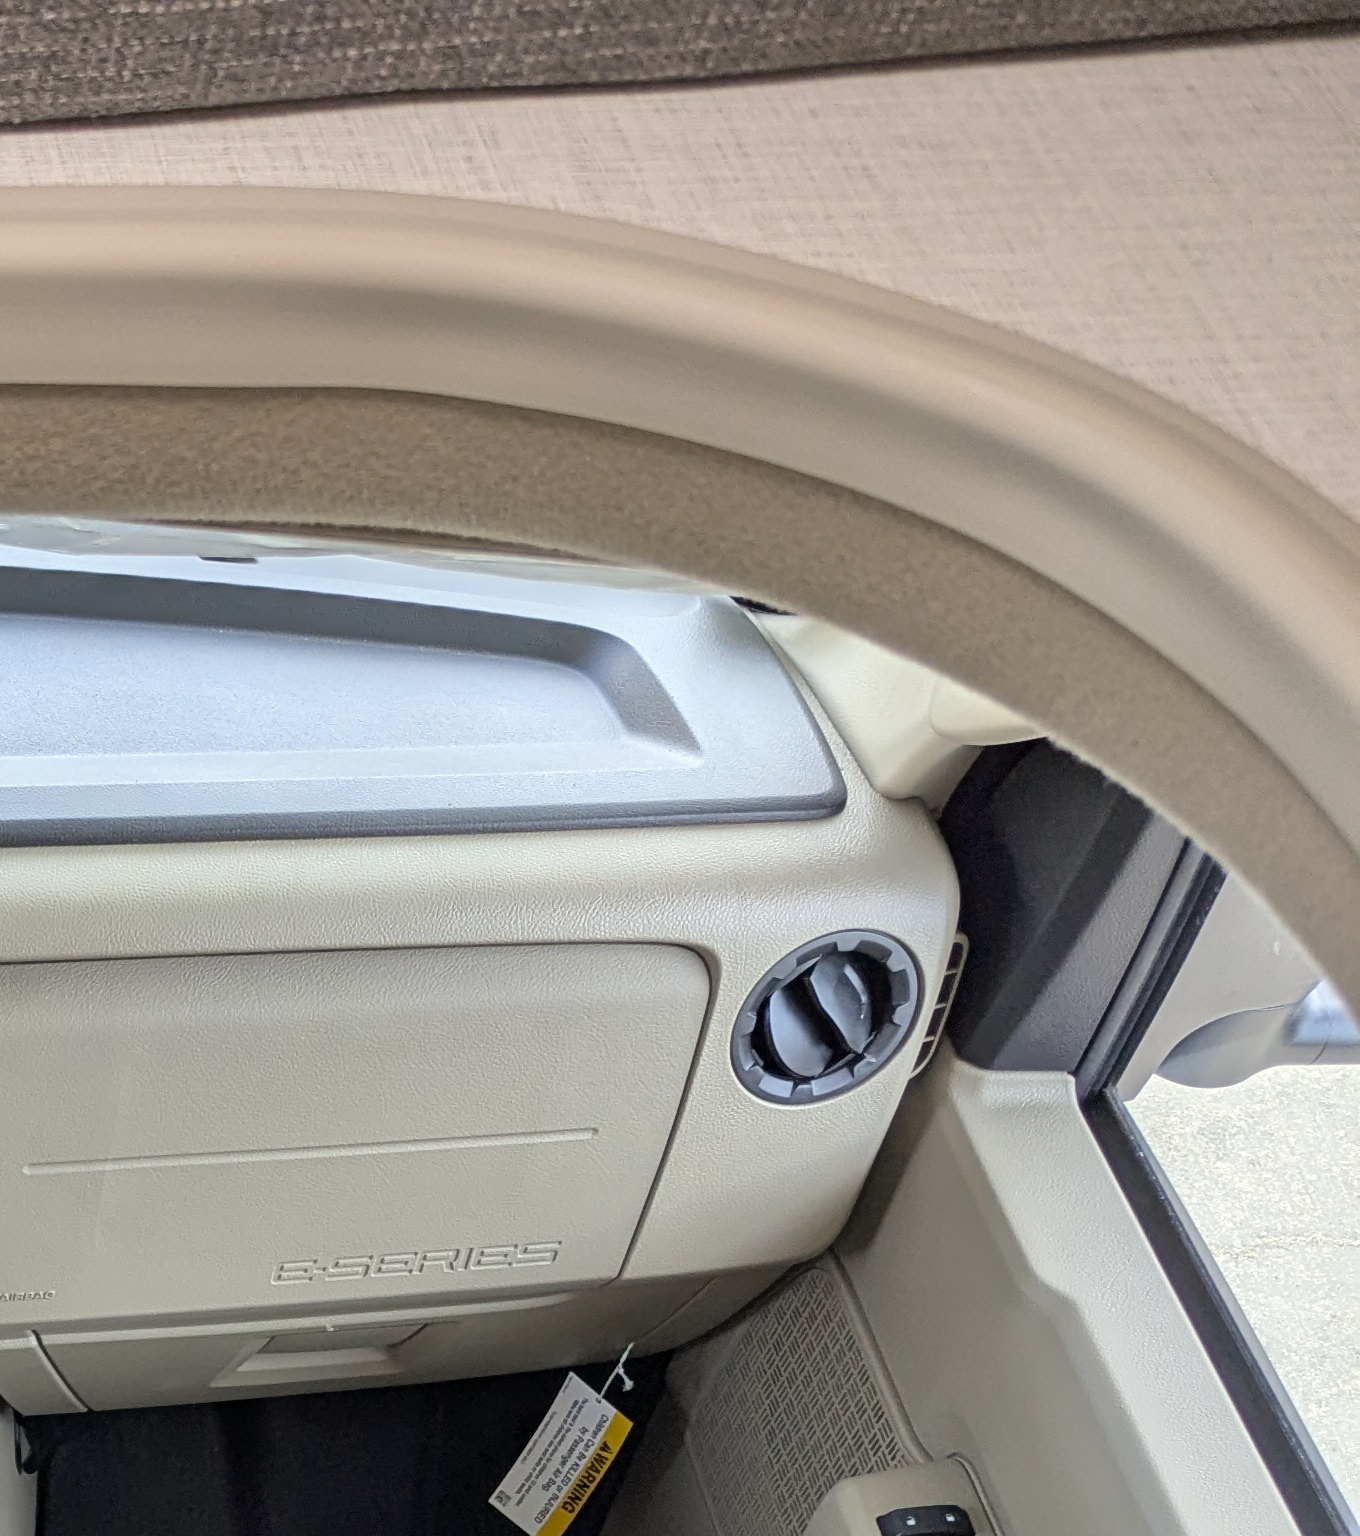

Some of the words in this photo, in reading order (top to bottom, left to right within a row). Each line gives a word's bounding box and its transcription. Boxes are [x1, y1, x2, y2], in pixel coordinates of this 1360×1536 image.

[270, 1241, 563, 1285] E-SERIES
[561, 1434, 584, 1469] Passenger
[583, 1439, 595, 1452] Can
[561, 1449, 609, 1514] WARNING
[562, 1462, 580, 1487] KILLED
[534, 1492, 560, 1524] INJURED
